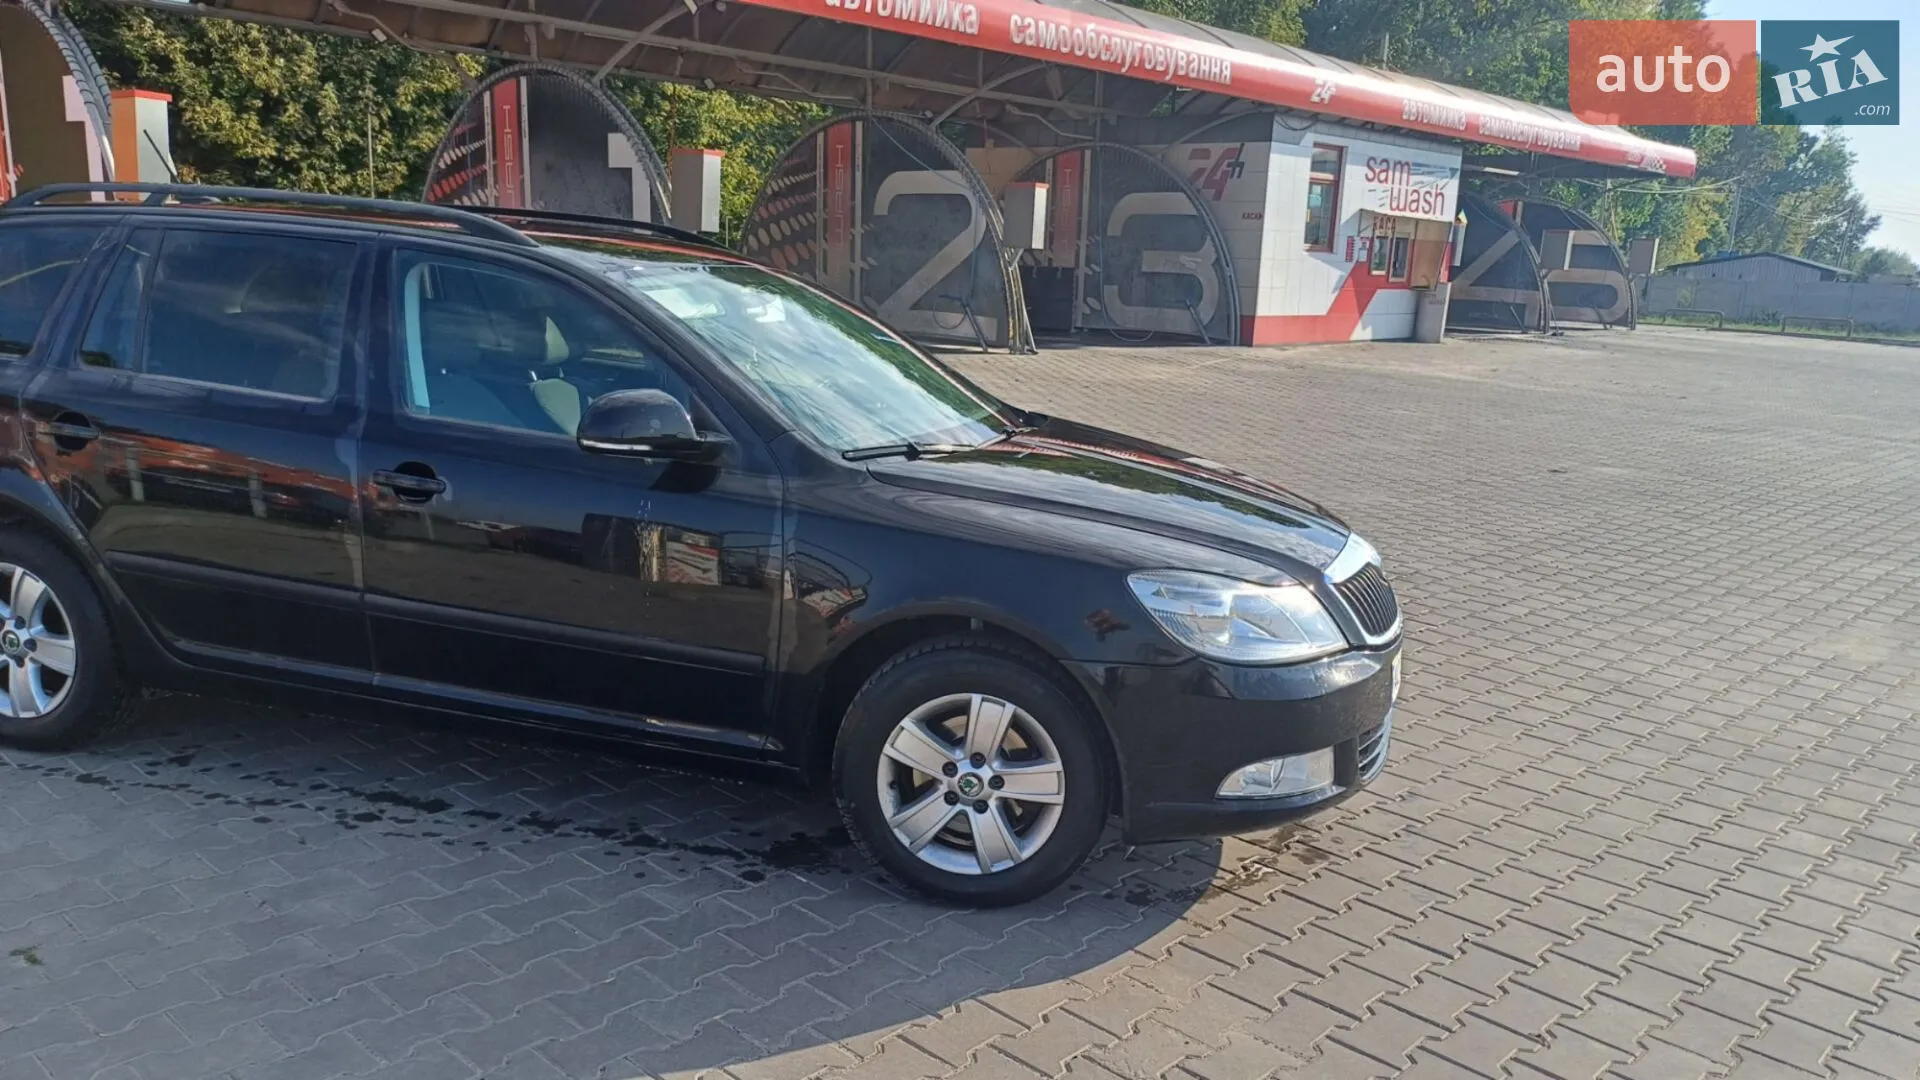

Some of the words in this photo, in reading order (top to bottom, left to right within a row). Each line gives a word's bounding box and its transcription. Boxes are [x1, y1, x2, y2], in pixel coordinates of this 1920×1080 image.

[825, 0, 979, 35] омийка
[1009, 12, 1232, 85] самообслуговування
[1364, 156, 1411, 186] sam
[1389, 184, 1445, 216] wash
[874, 170, 998, 342] 2
[1104, 192, 1219, 333] 3
[1450, 229, 1541, 331] 4
